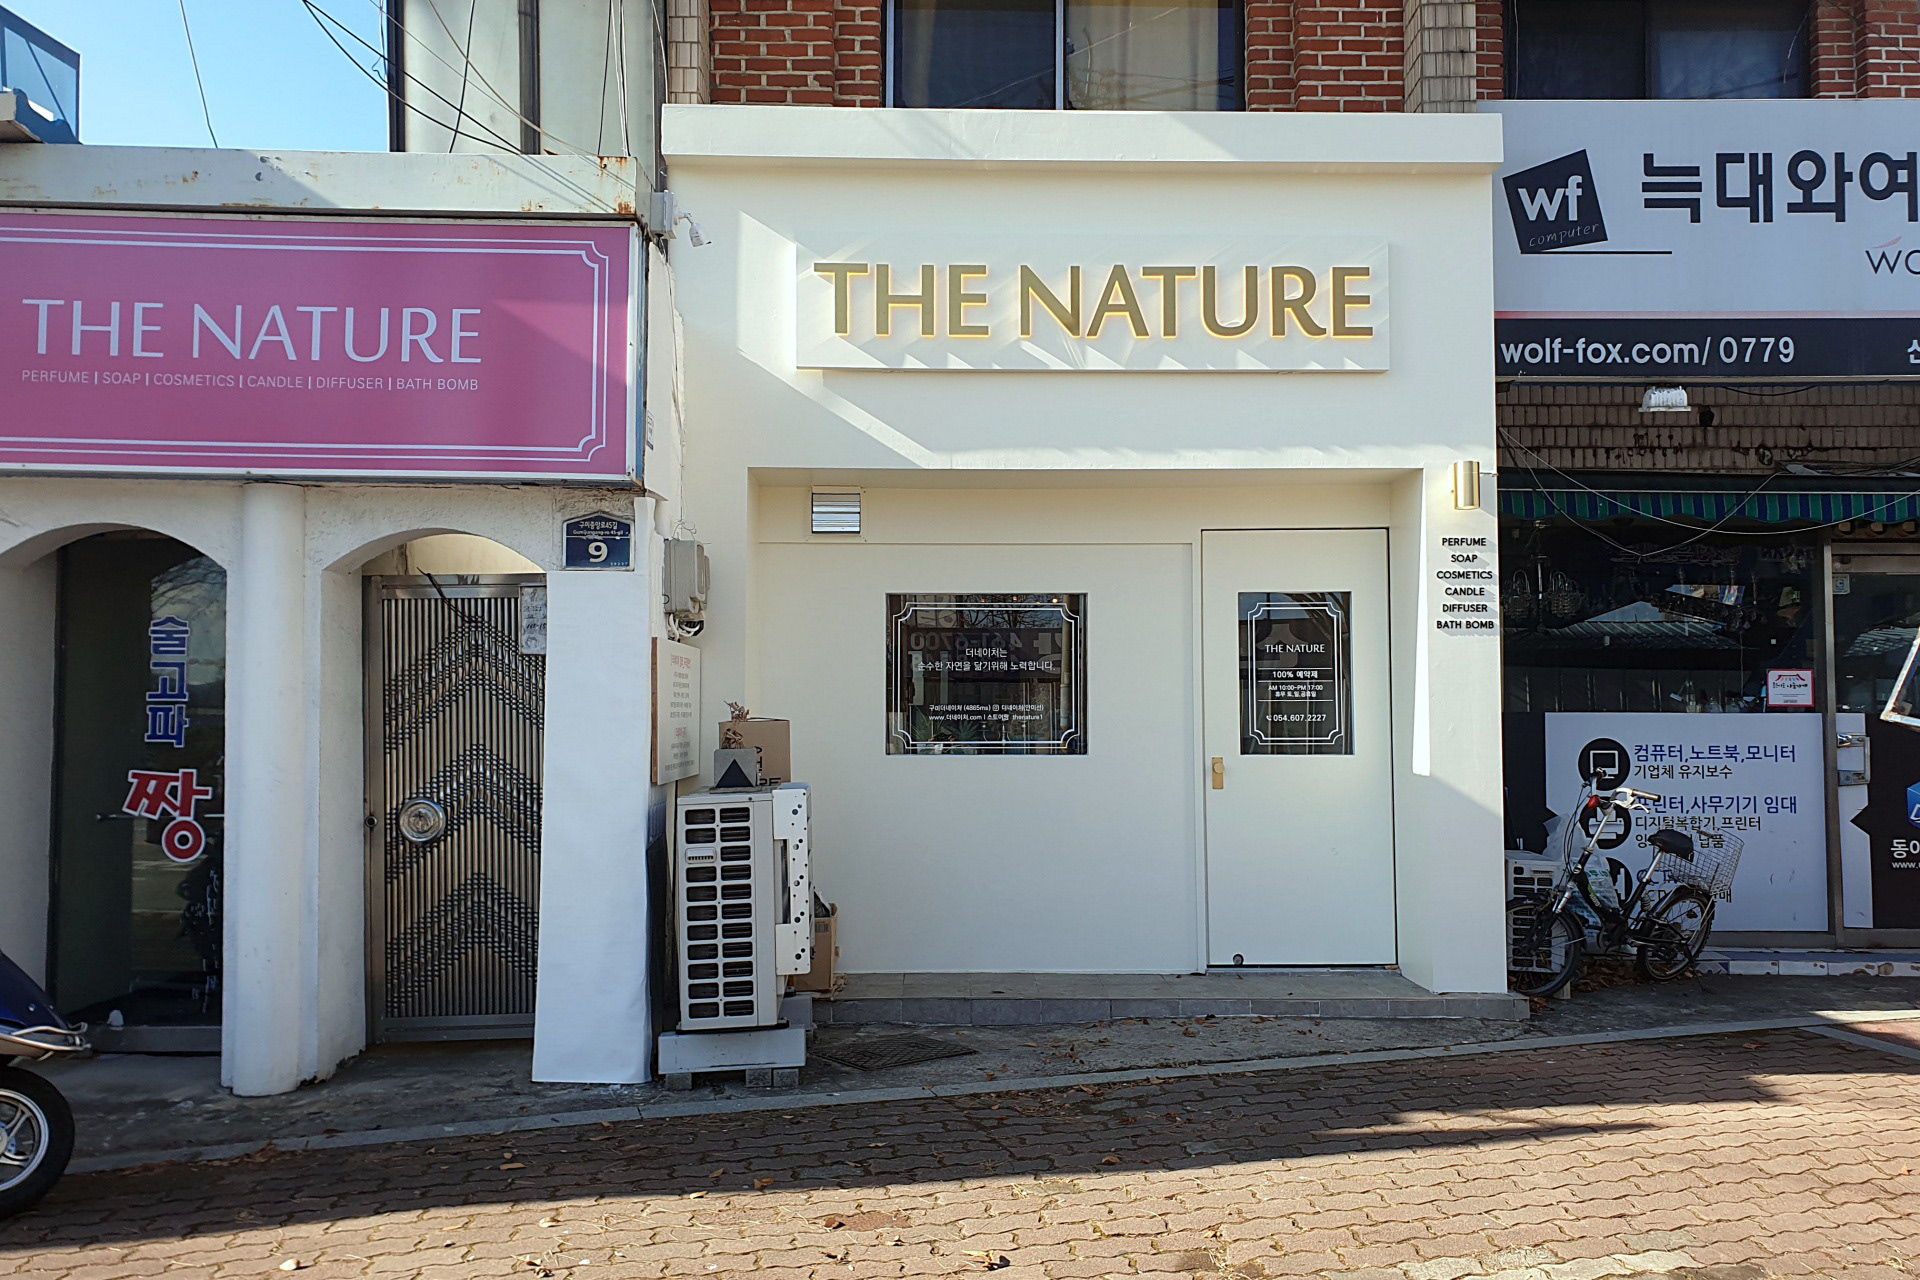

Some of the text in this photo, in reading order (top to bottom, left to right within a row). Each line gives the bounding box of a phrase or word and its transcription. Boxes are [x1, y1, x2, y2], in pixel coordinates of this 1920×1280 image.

[1516, 174, 1584, 222] wf
[1528, 222, 1600, 247] computer
[812, 261, 1377, 340] THE NATURE
[21, 298, 483, 364] THE NATURE
[1718, 336, 1796, 364] 0779
[21, 369, 479, 391] PERFUME SOAP COSMETICS CANDLE DIFFUSER BATH BOMB
[1441, 537, 1487, 546] PERFUME
[588, 541, 608, 563] 9
[1450, 554, 1478, 563] SOAP
[1436, 570, 1493, 579] COSMETICS
[1444, 587, 1485, 596] CANDLE
[1442, 603, 1488, 612] DIFFUSER
[1436, 620, 1495, 629] BATH BOMB
[965, 647, 1008, 658] 더네이처는
[1264, 644, 1326, 653] THE NATURE
[917, 661, 944, 671] 순수한
[945, 661, 971, 671] 자연을
[144, 615, 191, 748] 술고파
[1272, 670, 1318, 679] 100% 예약제
[1273, 714, 1327, 722] 054.607.2227
[1633, 743, 1796, 763] 컴퓨터,노트북,모니터
[1633, 764, 1733, 780] 기업체 유지보수
[1764, 795, 1798, 814] 임대
[122, 768, 213, 863] 짱
